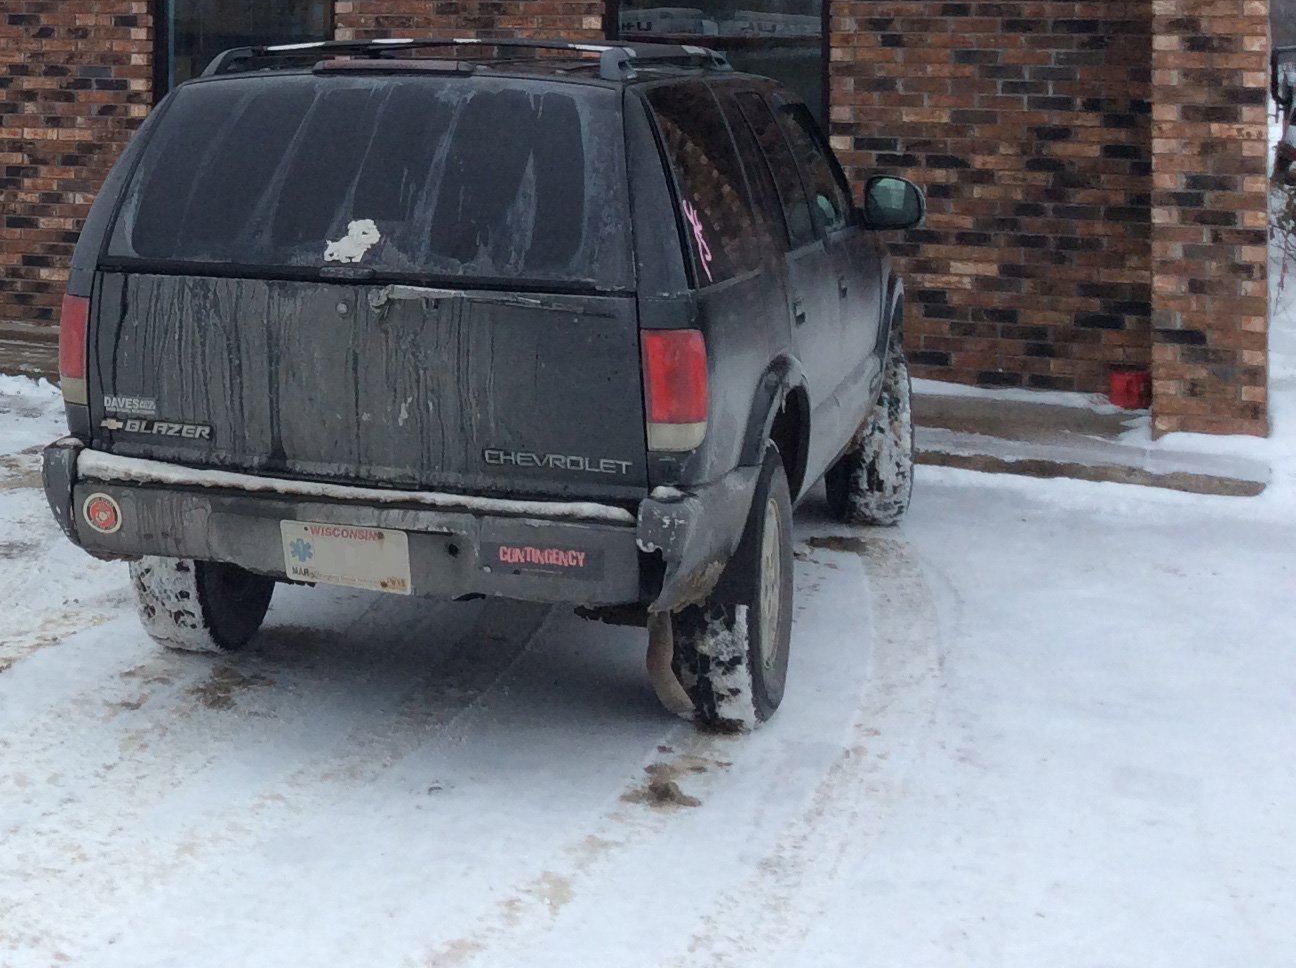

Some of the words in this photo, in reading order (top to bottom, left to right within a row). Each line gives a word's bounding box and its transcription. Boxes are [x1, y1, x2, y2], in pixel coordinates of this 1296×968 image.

[104, 396, 140, 409] DAVES
[124, 418, 211, 439] BLAZER
[484, 449, 633, 474] CHEVROLET
[310, 526, 380, 541] WISCONSIN
[499, 545, 586, 567] CONTINGENCY
[292, 566, 310, 577] MAR
